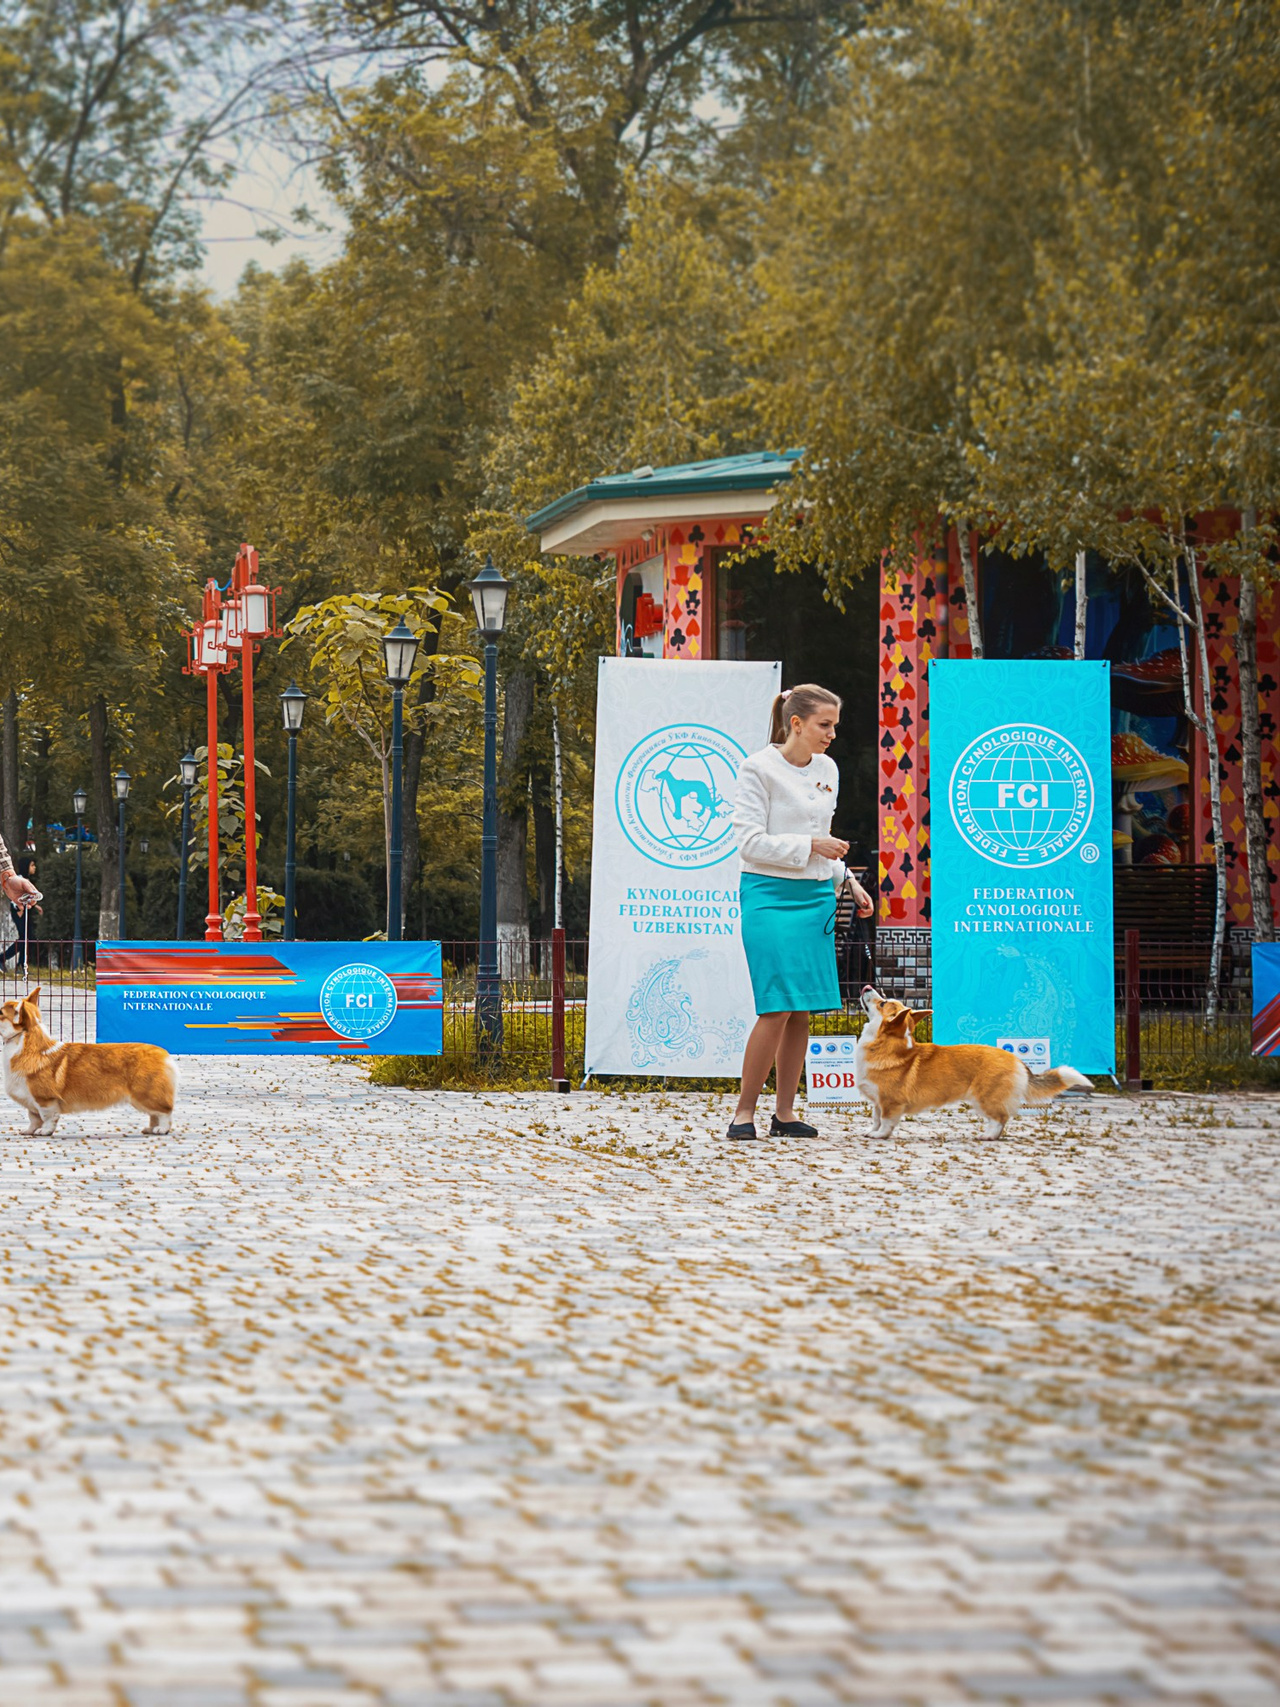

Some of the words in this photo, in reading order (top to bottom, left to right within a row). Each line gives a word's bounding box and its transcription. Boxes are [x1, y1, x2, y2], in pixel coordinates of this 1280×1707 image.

[961, 731, 1057, 776] CYNOLOGIQUE
[998, 783, 1049, 808] FCI
[1038, 747, 1087, 859] INTERNATIONALE
[956, 779, 1008, 858] FEDERATION
[627, 888, 740, 902] KYNOLOGICAL
[973, 888, 1075, 900] FEDERATION
[619, 904, 722, 918] FEDERATION
[728, 907, 739, 919] O
[965, 904, 1083, 917] CYNOLOGIQUE
[633, 921, 734, 935] UZBEKISTAN
[954, 921, 1095, 933] INTERNATIONALE
[326, 967, 377, 991] CYNOLOGIQUE
[123, 990, 188, 999] FEDERATION
[190, 990, 266, 1001] CYNOLOGIQUE
[345, 993, 373, 1008] FCI
[123, 1002, 213, 1011] INTERNATIONALE
[366, 976, 393, 1034] INTERNATIONALE
[324, 992, 351, 1034] FEDERATION
[811, 1072, 855, 1089] BOB
